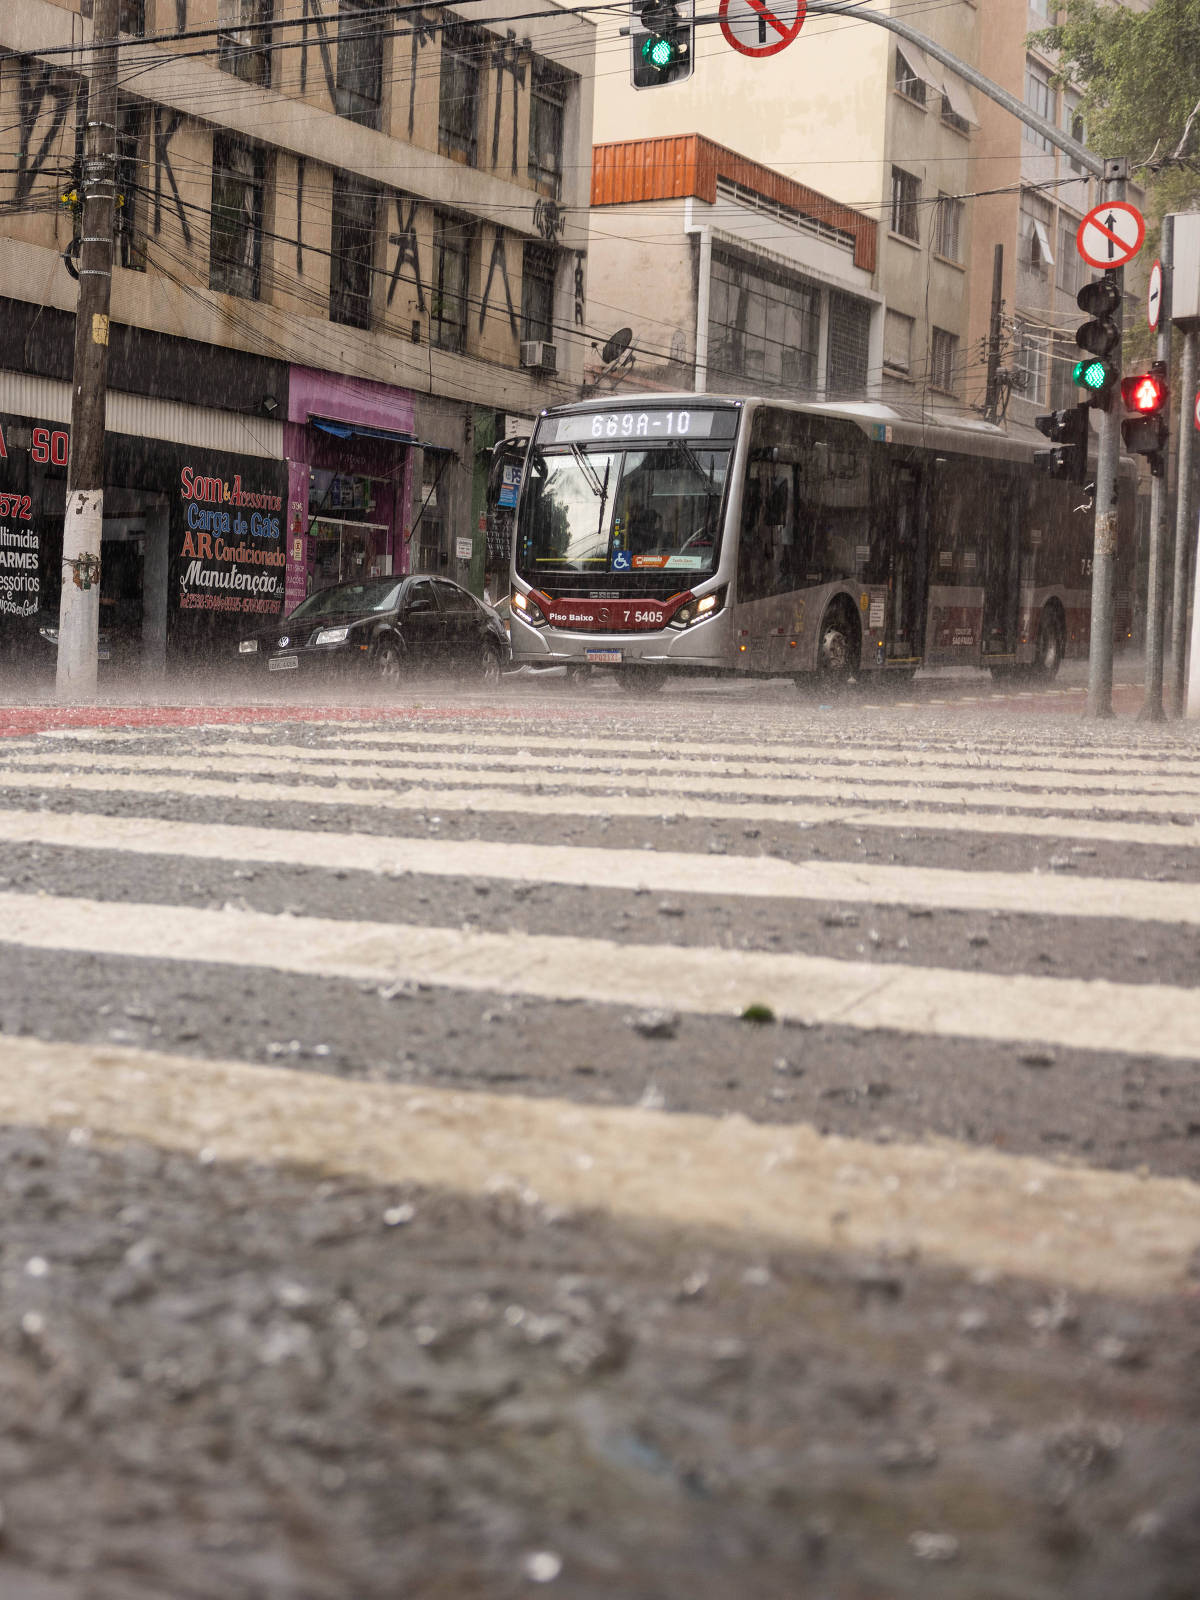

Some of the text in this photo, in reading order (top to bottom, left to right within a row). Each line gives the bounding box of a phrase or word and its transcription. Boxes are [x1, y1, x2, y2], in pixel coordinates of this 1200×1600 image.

[591, 410, 691, 438] 669A-10
[31, 427, 70, 467] SO
[180, 466, 224, 504] Som
[228, 474, 283, 511] Acessórios
[187, 502, 280, 540] Carga de Gás
[180, 531, 214, 560] AR
[214, 537, 286, 568] Condicionado
[7, 591, 13, 600] e
[180, 560, 278, 596] Manutenção
[550, 611, 663, 623] Piso Baixo 7 5405
